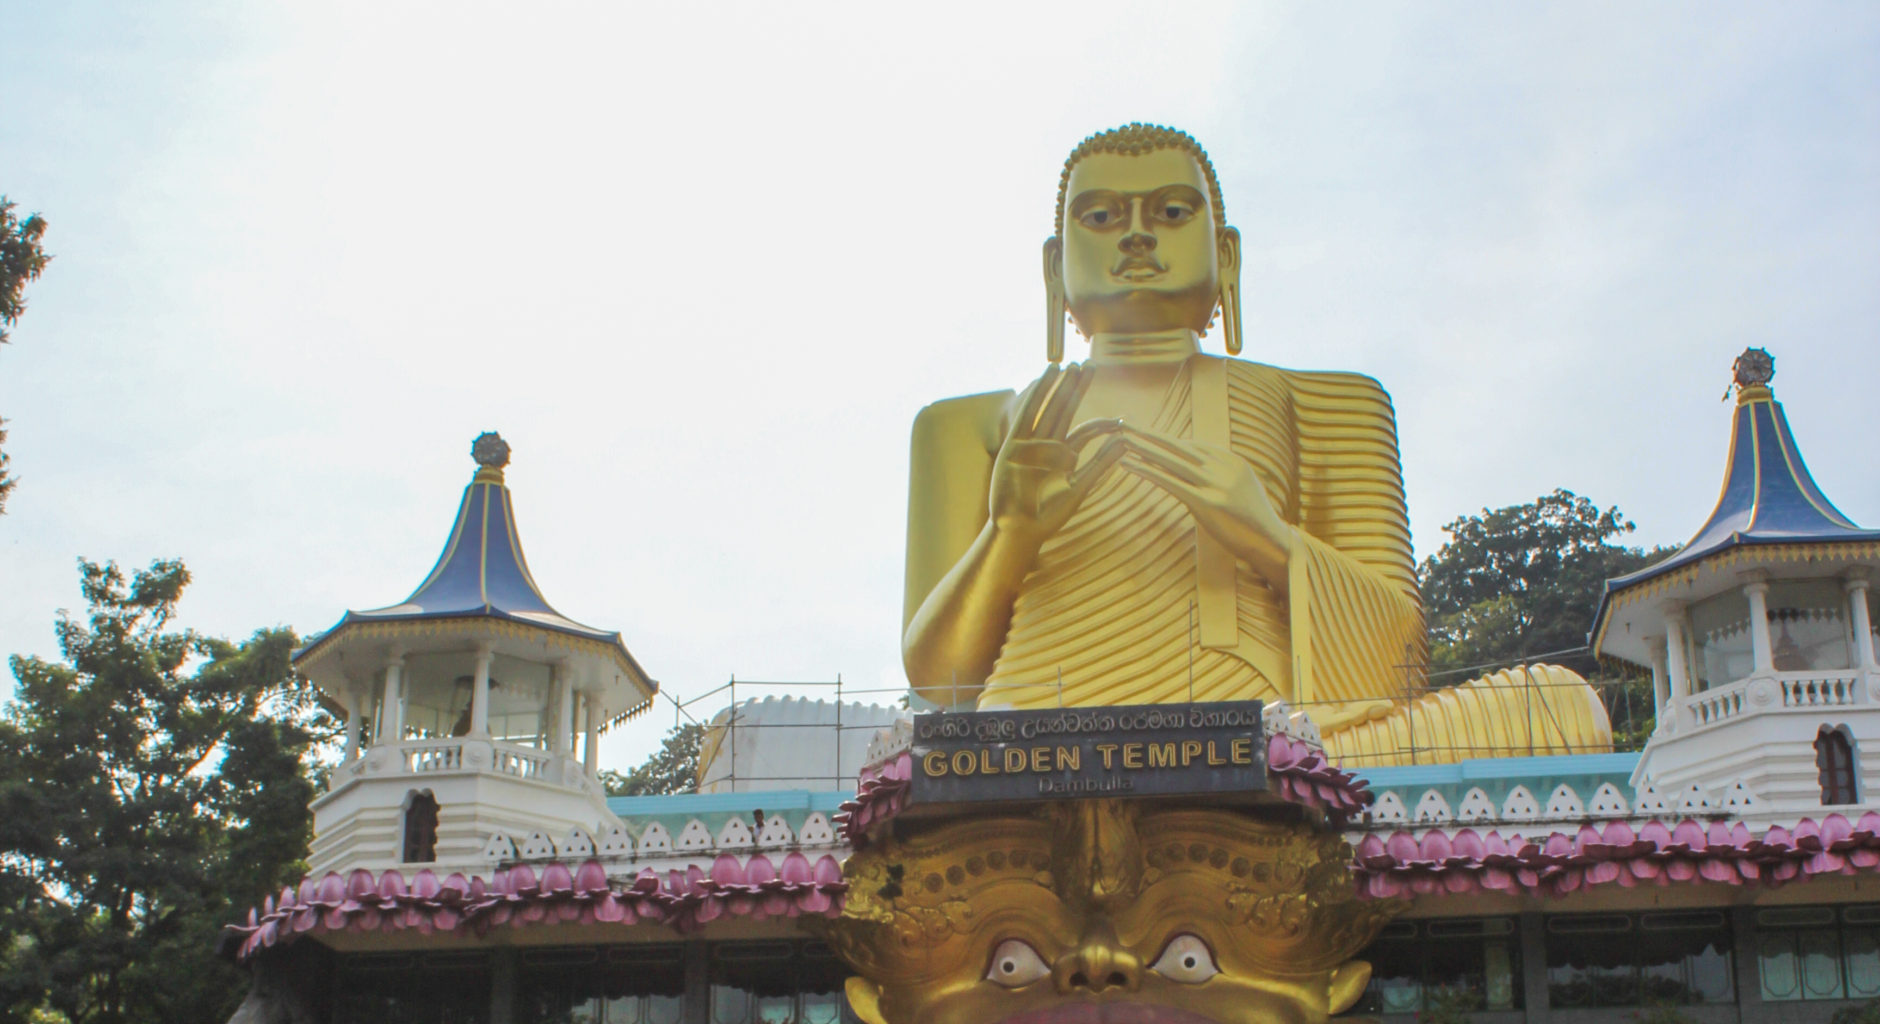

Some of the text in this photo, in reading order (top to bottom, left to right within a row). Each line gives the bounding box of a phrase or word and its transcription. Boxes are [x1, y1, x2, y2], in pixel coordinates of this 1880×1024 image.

[1189, 705, 1256, 728] විහාරය
[922, 738, 1253, 777] GOLDEN TEMPLE
[1038, 774, 1135, 793] Dambulla
